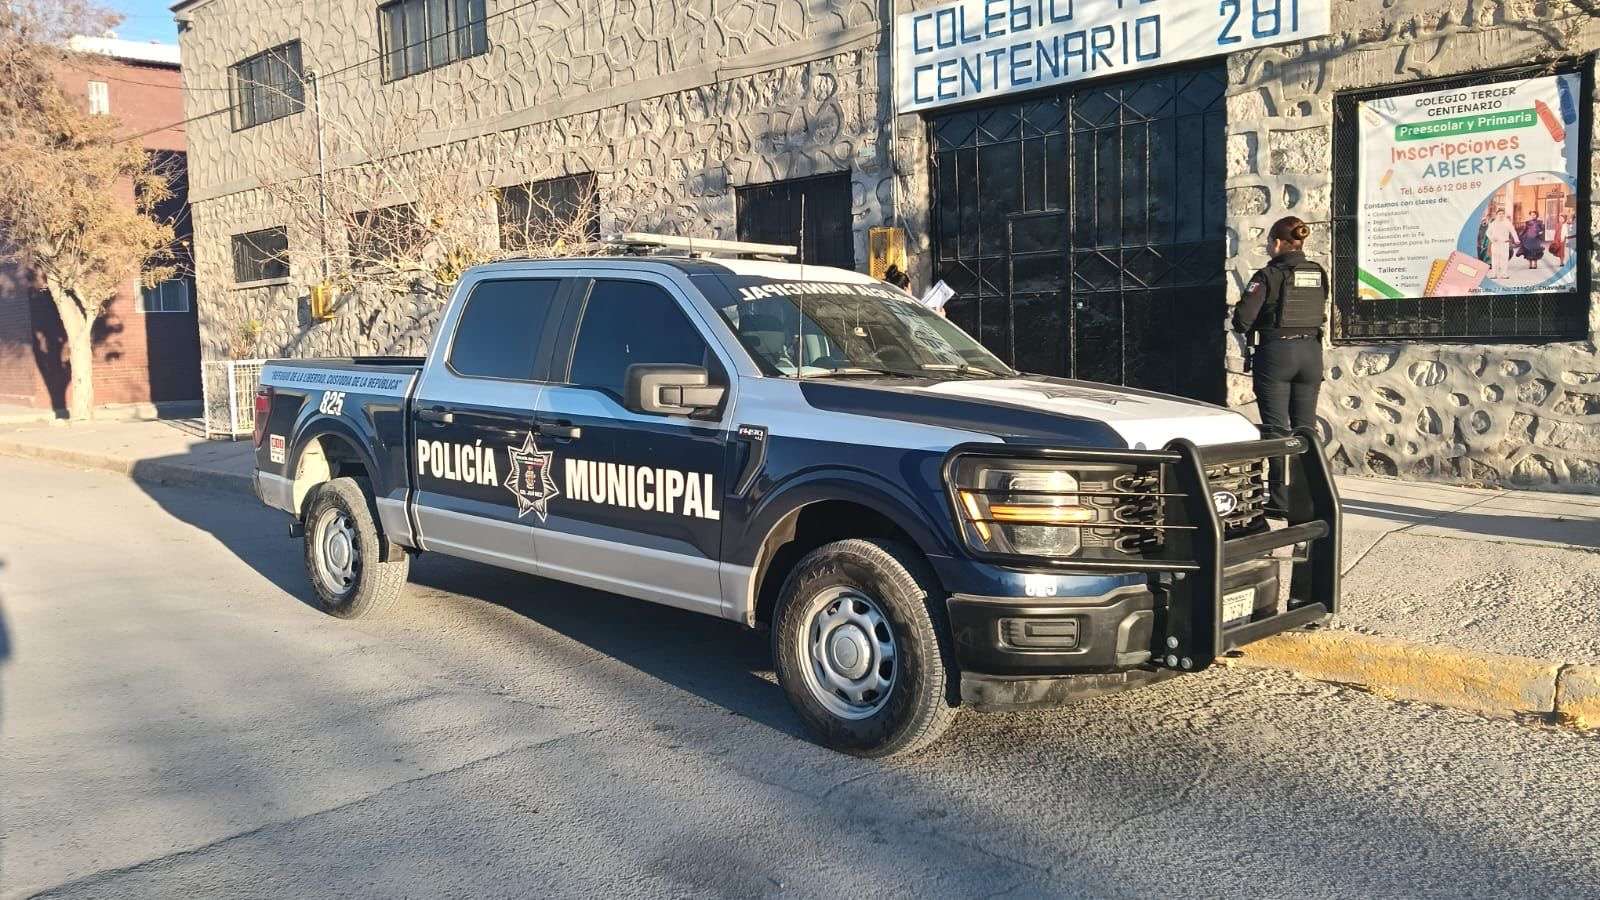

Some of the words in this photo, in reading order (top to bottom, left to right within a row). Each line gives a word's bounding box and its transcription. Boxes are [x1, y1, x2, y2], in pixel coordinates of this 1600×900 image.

[914, 15, 1160, 104] CENTENARIO
[1415, 93, 1467, 107] COLEGIO
[1471, 87, 1517, 100] TERCER
[1427, 100, 1502, 117] CENTENARIO
[1400, 121, 1464, 137] Preescolar
[1467, 120, 1475, 130] y
[1478, 112, 1532, 127] Primaria
[1391, 136, 1520, 163] Inscripciones
[1422, 154, 1526, 179] ABIERTAS
[319, 390, 346, 416] 825
[417, 439, 499, 487] POLICÍA
[565, 457, 721, 521] MUNICIPAL
